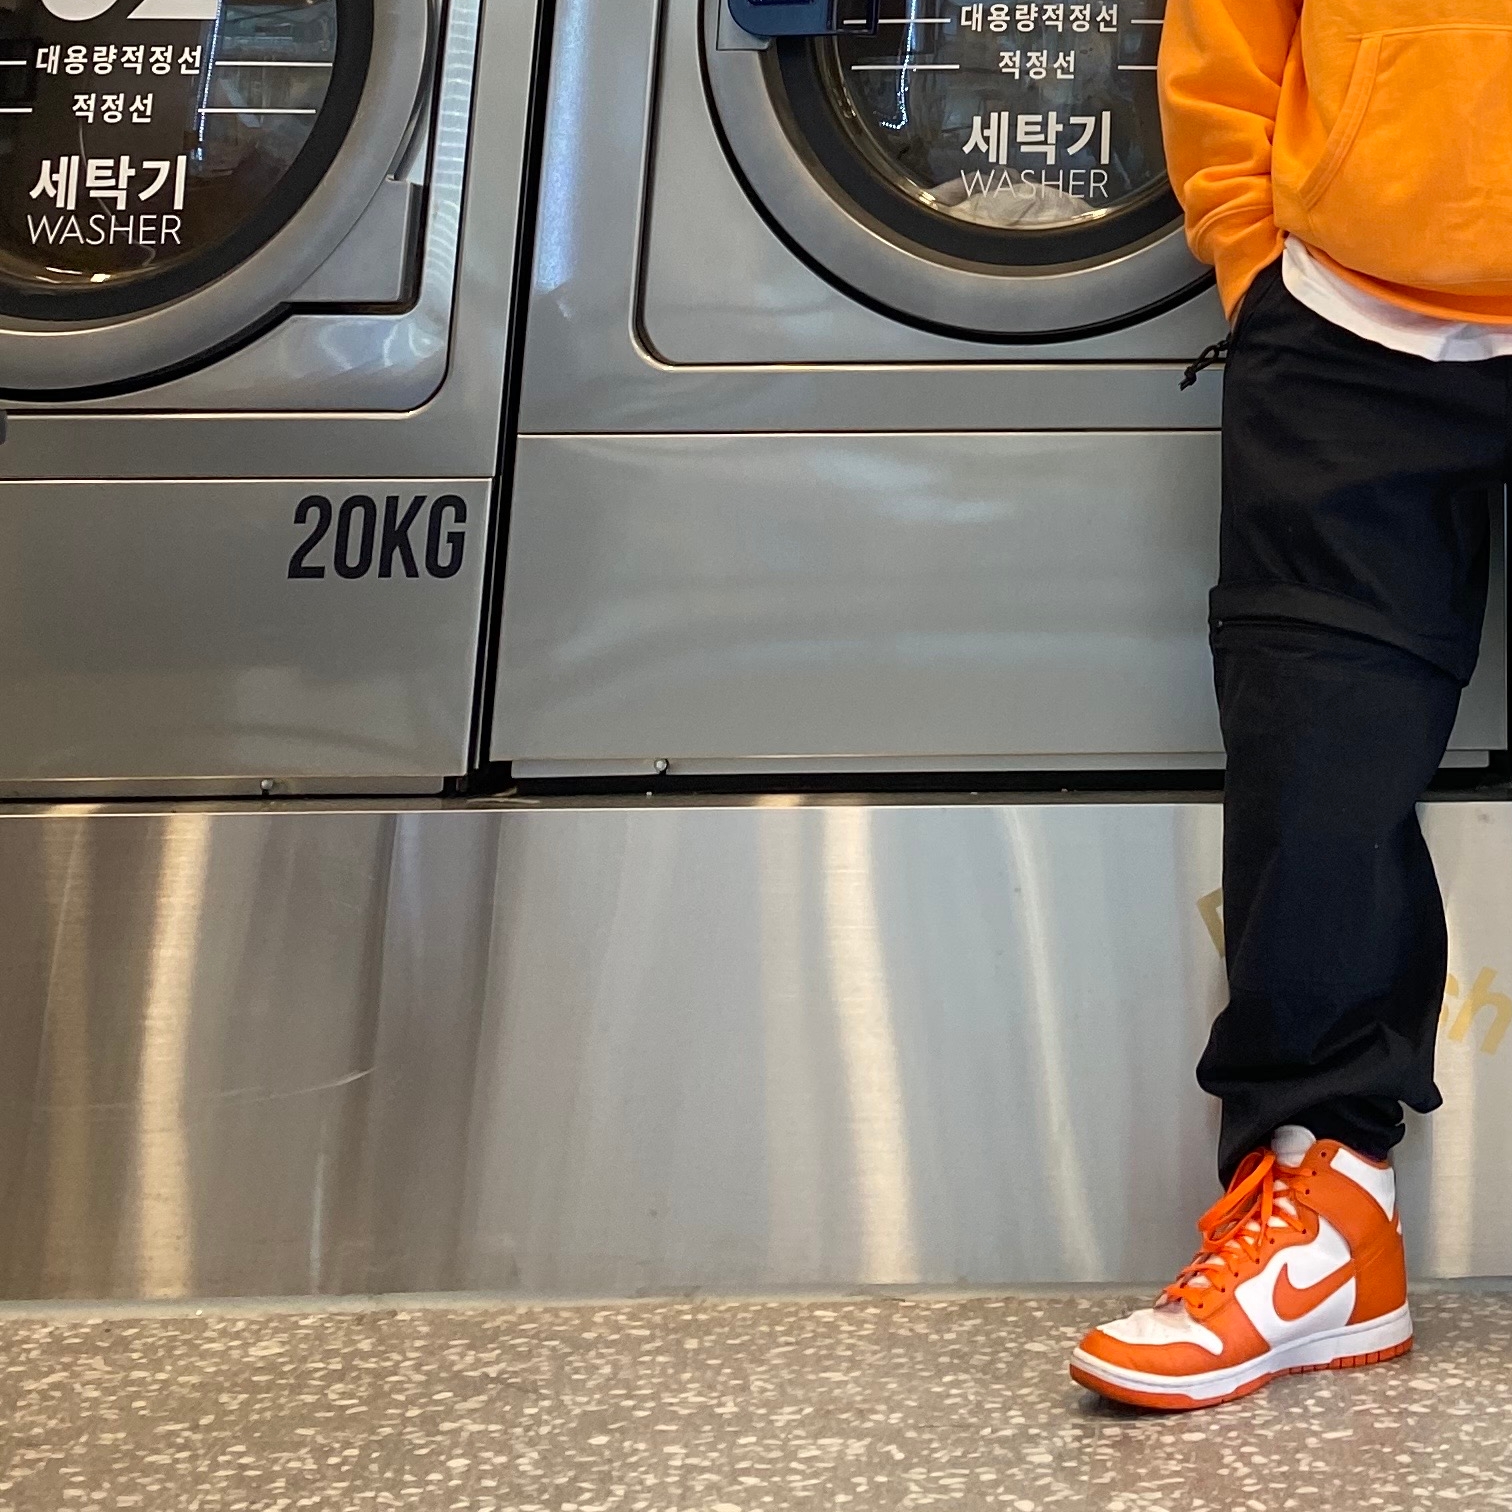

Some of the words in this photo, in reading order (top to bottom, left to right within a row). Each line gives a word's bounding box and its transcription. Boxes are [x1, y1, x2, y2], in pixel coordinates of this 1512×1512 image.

[960, 2, 1118, 32] 대용량적정선
[36, 45, 202, 74] 대용량적정선
[999, 50, 1075, 79] 적정선
[72, 93, 153, 124] 적정선
[962, 111, 1110, 165] 세탁기
[29, 155, 187, 210] 세탁기
[960, 169, 1108, 198] WASHER
[27, 214, 181, 245] WASHER
[287, 494, 467, 579] 20KG
